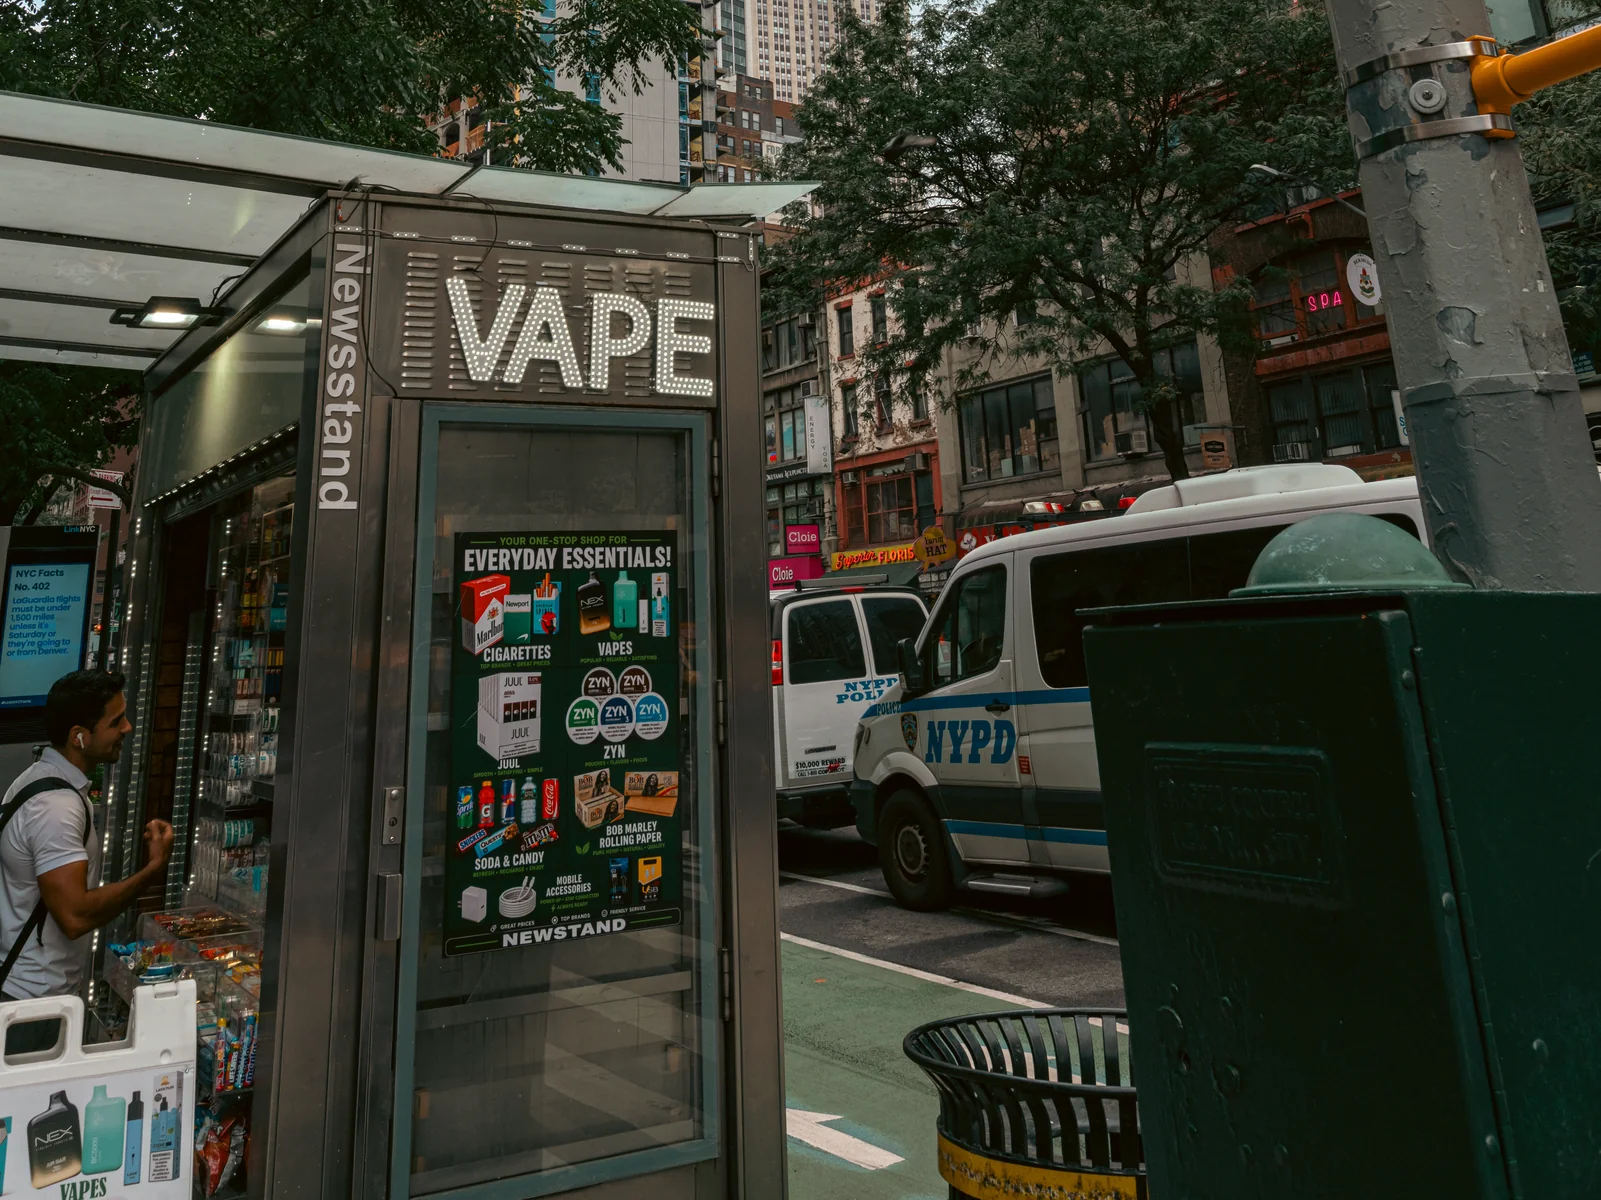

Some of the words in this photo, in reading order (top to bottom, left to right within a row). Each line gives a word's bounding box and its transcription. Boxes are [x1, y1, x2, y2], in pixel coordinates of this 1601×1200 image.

[1308, 291, 1342, 311] SPA
[445, 276, 715, 397] VAPE
[318, 243, 373, 510] Newsstand
[63, 525, 96, 533] LinkNYC
[500, 537, 526, 545] YOUR
[529, 536, 577, 545] ONE-STOP
[580, 536, 605, 544] SHOP
[609, 536, 627, 544] FOR
[789, 531, 817, 542] Cloie
[925, 544, 947, 557] HAT
[464, 547, 557, 571] EVERYDAY
[562, 546, 671, 569] ESSENTIALS!
[835, 550, 876, 569] Superior
[878, 547, 915, 563] FLORIS
[15, 570, 36, 578] NYC
[38, 569, 64, 577] Facts
[772, 566, 793, 581] Cloie
[14, 583, 30, 591] No.
[32, 582, 50, 590] 402
[12, 596, 55, 604] LaGuardia
[56, 595, 81, 604] flights
[580, 595, 604, 607] NEX
[12, 605, 33, 613] must
[35, 604, 45, 612] be
[47, 604, 71, 612] under
[11, 613, 31, 622] 1,500
[10, 622, 36, 630] unless
[9, 630, 46, 639] Saturday
[8, 639, 35, 649] they're
[37, 638, 60, 648] going
[62, 638, 70, 646] to
[597, 641, 633, 656] VAPES
[16, 648, 36, 656] from
[38, 647, 69, 655] Denver.
[483, 645, 551, 662] CIGARETTES
[588, 676, 610, 688] ZYN
[623, 675, 645, 686] ZYN
[836, 690, 884, 704] POLI
[573, 707, 595, 720] ZYN
[605, 705, 627, 718] ZYN
[639, 703, 661, 715] ZYN
[876, 700, 902, 716] POLICE
[925, 720, 1016, 764] NYPD
[603, 744, 626, 759] ZYN
[497, 758, 520, 770] JUUL
[796, 760, 820, 770] $10,000
[821, 757, 846, 766] REWARD
[481, 805, 491, 817] G
[606, 825, 623, 836] BOB
[625, 821, 658, 834] MARLEY
[459, 829, 487, 851] SNICKERS
[599, 835, 635, 849] ROLLING
[636, 832, 662, 844] PAPER
[474, 856, 500, 871] SODA
[503, 855, 510, 867] &
[512, 851, 545, 866] CANDY
[500, 866, 525, 874] RECHARGE
[556, 874, 582, 886] MOBILE
[545, 883, 592, 897] ACCESSORIES
[557, 902, 574, 910] ALWAYS
[610, 907, 628, 915] FRIENDLY
[500, 922, 516, 930] GREAT
[517, 920, 535, 928] PRICES
[502, 918, 626, 947] NEWSTAND
[34, 1125, 73, 1147] NEX
[60, 1177, 107, 1200] VAPES
